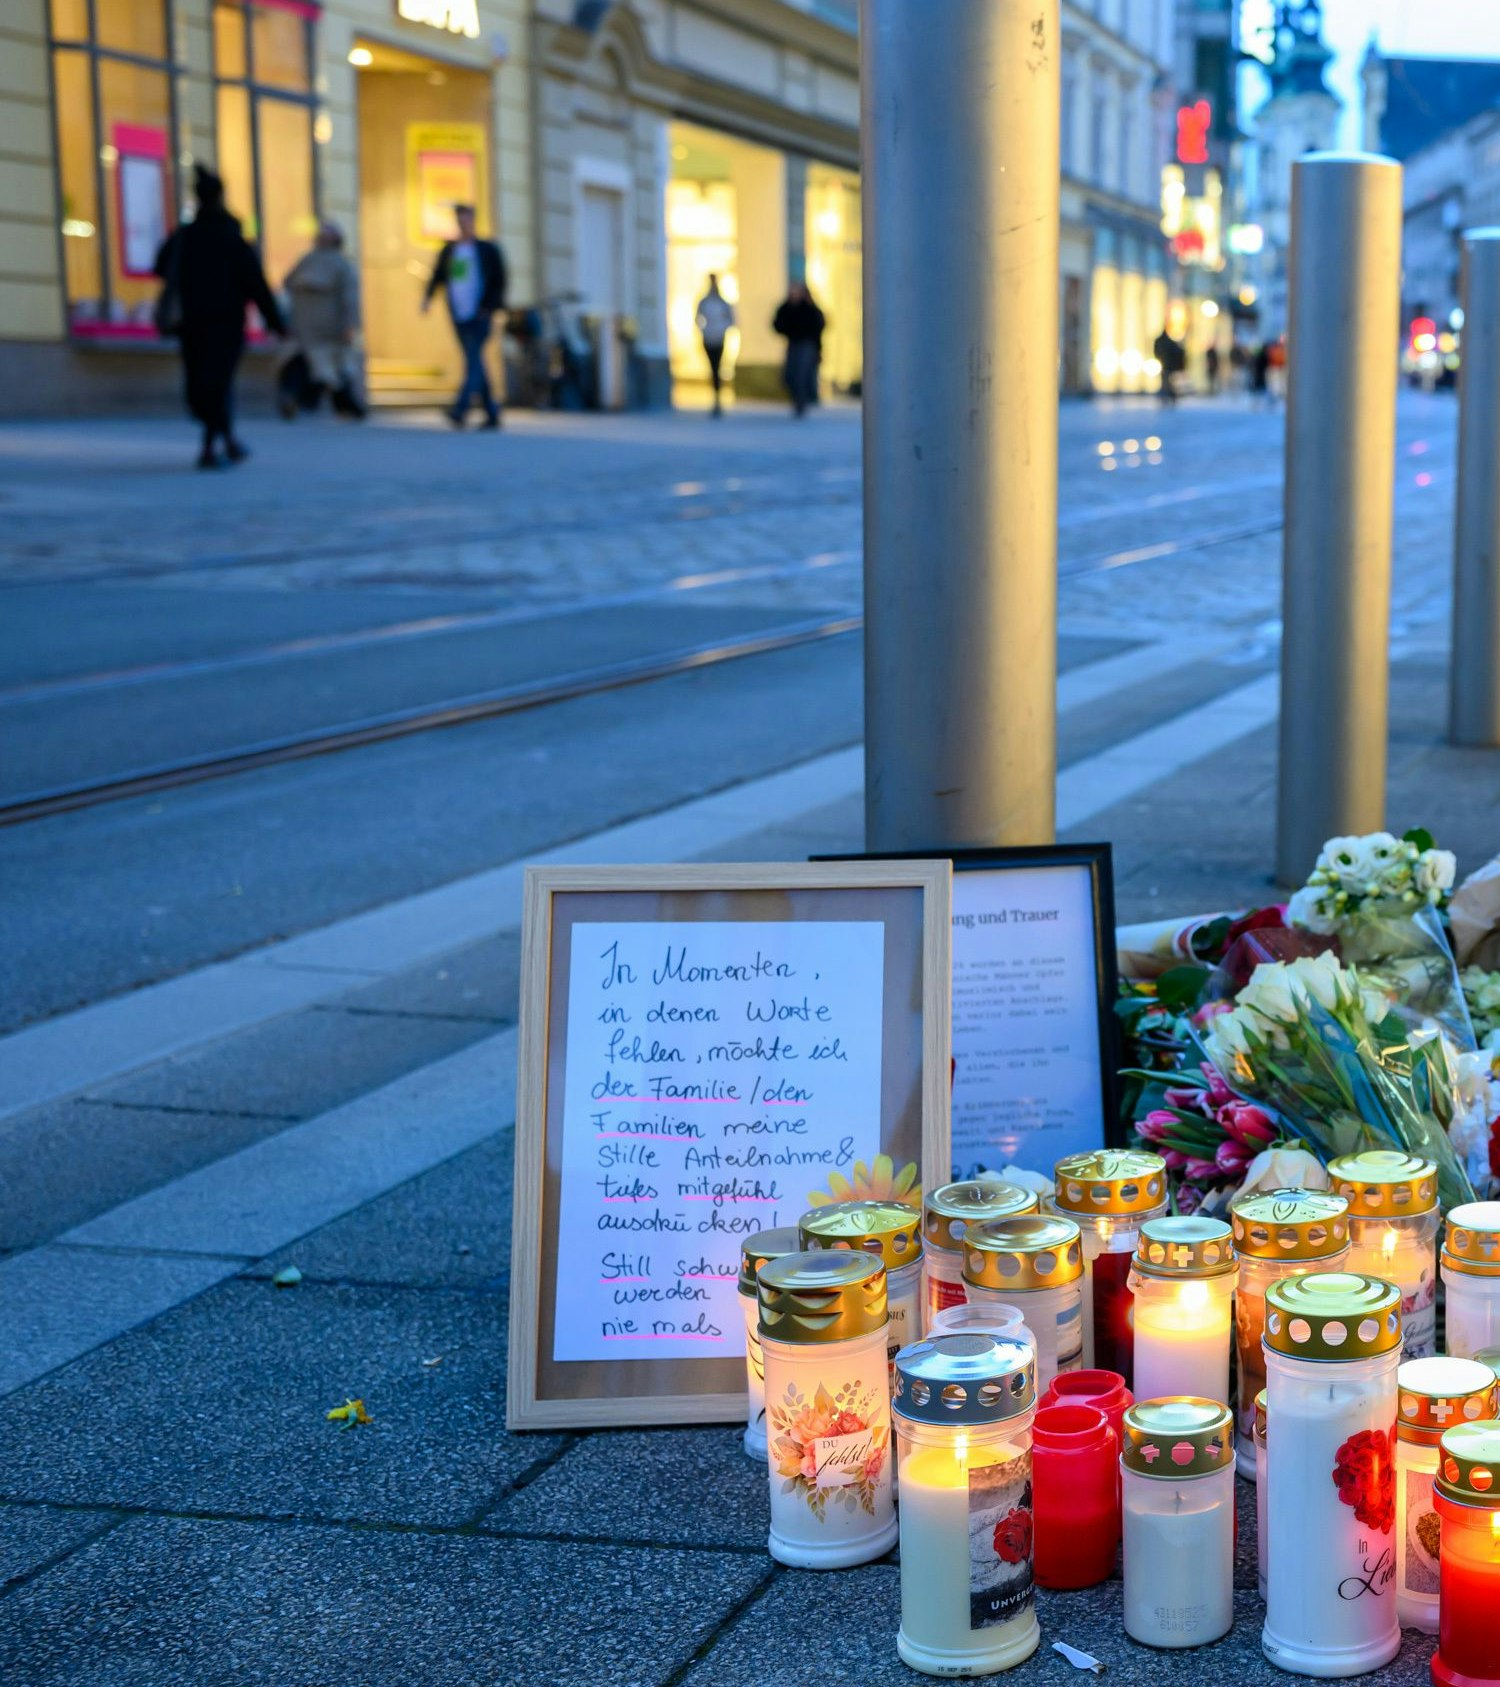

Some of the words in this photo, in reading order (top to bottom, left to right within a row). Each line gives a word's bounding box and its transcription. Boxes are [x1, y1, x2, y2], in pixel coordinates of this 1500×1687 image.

[951, 914, 975, 929] ung
[978, 908, 1007, 925] und
[1009, 909, 1060, 923] Trauer
[600, 940, 638, 990] In
[598, 1002, 632, 1024] in
[646, 1000, 720, 1024] denen
[808, 1036, 848, 1062] ich
[591, 1071, 637, 1099] der
[648, 1076, 742, 1101] Familie
[590, 1111, 707, 1139] Familien
[723, 1115, 809, 1137] meine
[598, 1145, 661, 1169] Stille
[678, 1176, 783, 1208] mitgefühl
[601, 1252, 651, 1279] Still
[614, 1280, 712, 1305] werden
[822, 1439, 839, 1449] DU
[1358, 1538, 1369, 1554] In
